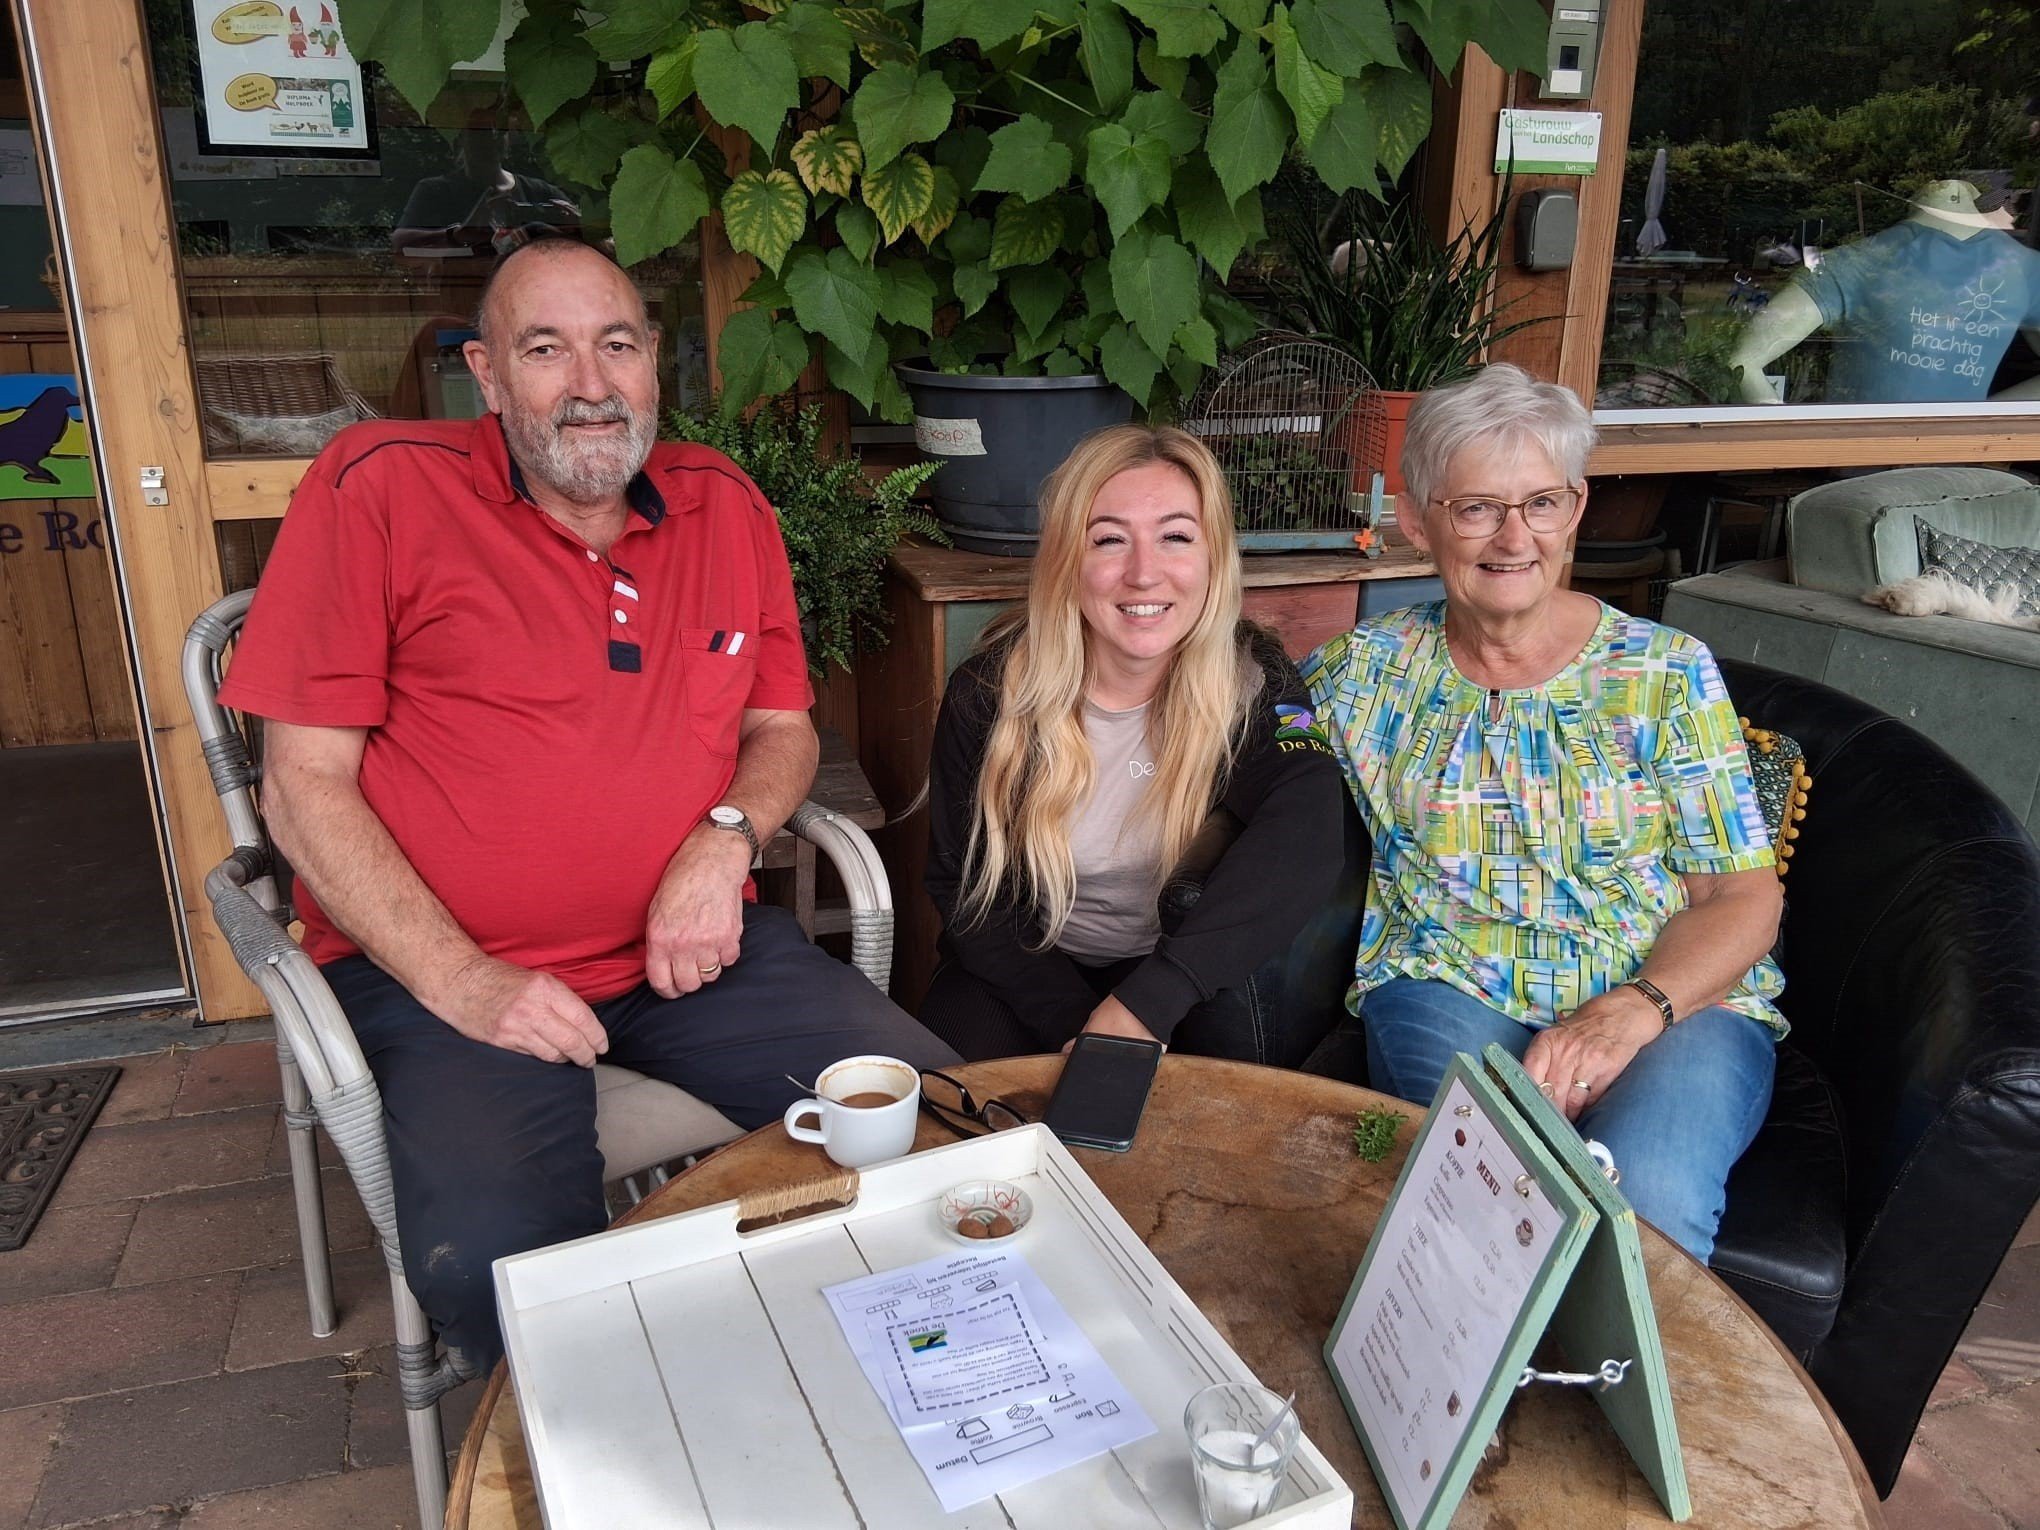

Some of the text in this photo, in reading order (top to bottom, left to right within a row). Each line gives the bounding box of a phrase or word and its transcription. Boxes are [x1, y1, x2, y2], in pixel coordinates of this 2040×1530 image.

[1533, 131, 1594, 149] Landschap
[1910, 306, 1940, 328] Het
[1965, 321, 2000, 339] een
[1911, 332, 1983, 365] prachtig
[1890, 347, 1985, 386] mooie dag
[1278, 740, 1306, 753] De
[1129, 760, 1156, 779] De
[1446, 1150, 1465, 1177] KOFFIE
[1476, 1160, 1501, 1196] MENU
[1413, 1223, 1428, 1246] THEE
[1385, 1287, 1403, 1319] DIVERS
[1075, 1410, 1093, 1420] Bon
[936, 1456, 968, 1471] Datum
